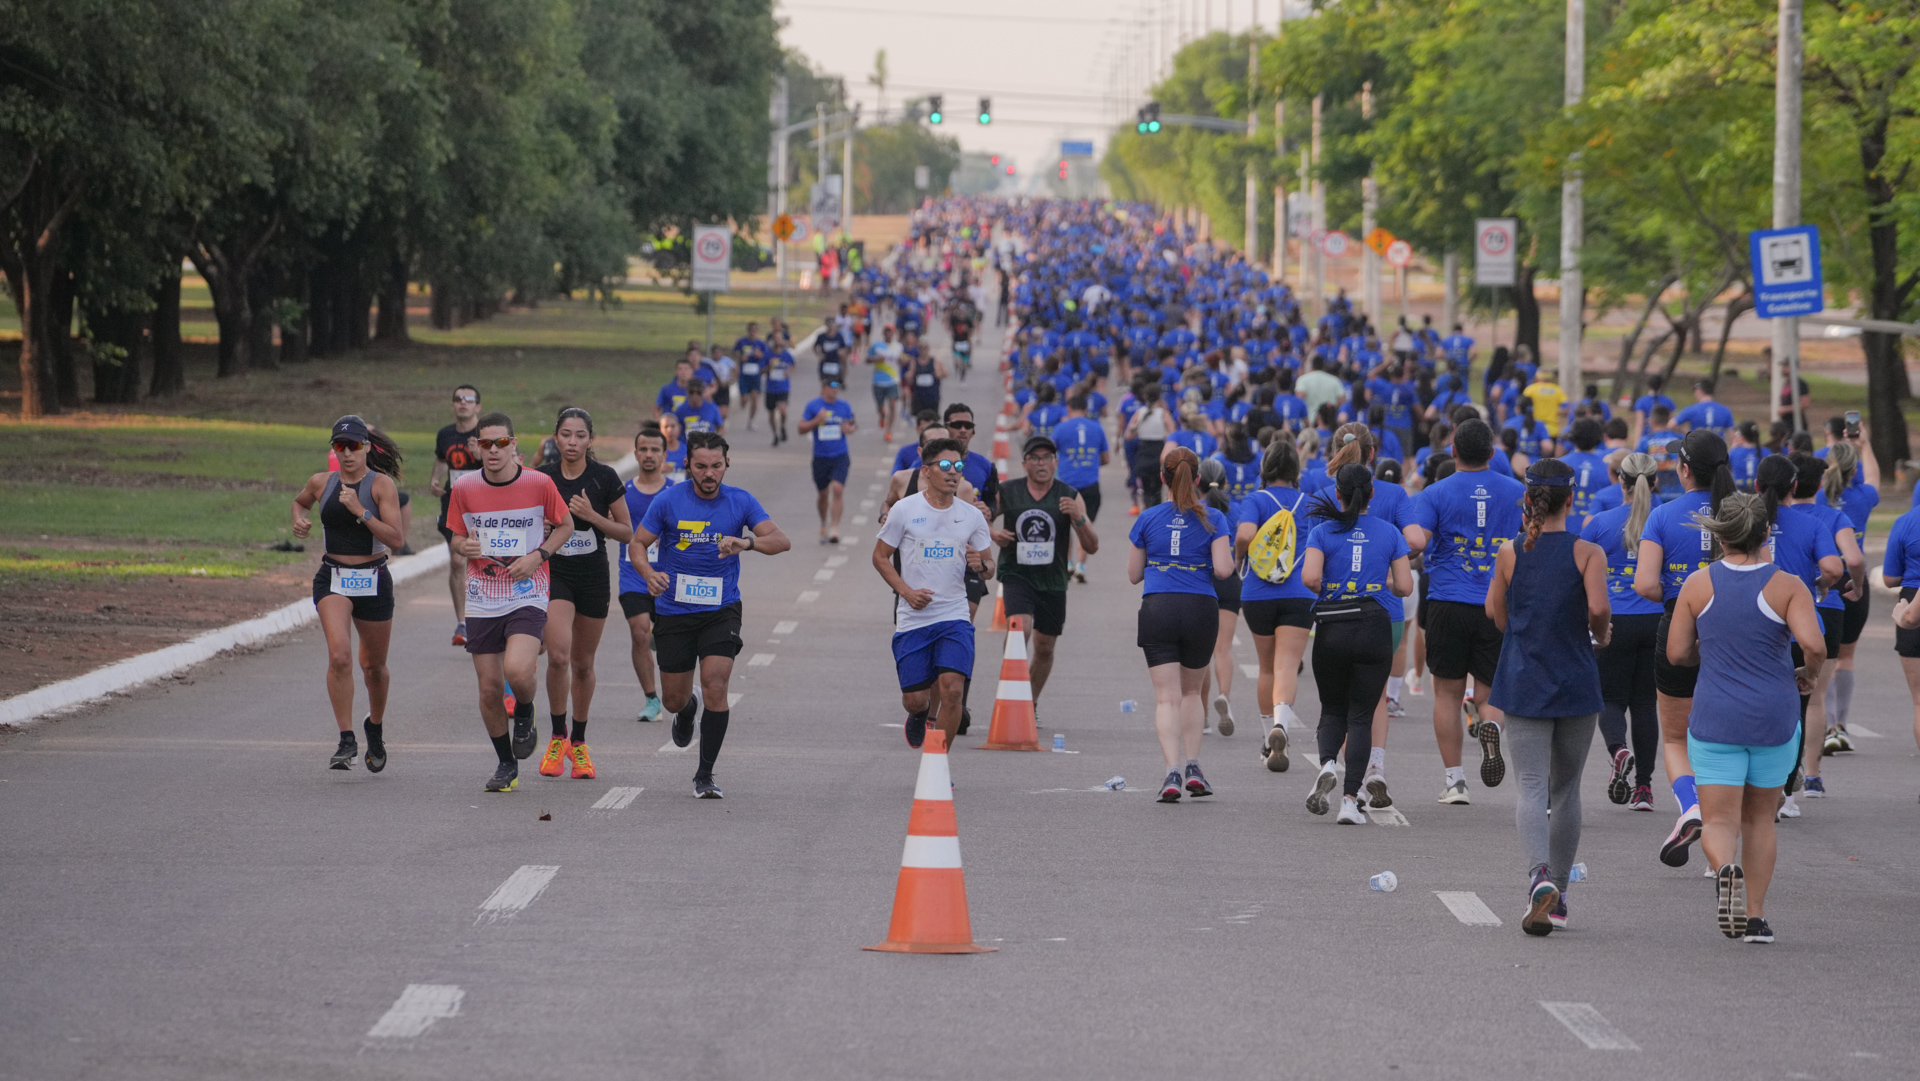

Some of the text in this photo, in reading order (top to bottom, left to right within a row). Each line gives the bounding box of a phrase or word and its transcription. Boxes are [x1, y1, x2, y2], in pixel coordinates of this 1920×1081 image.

[484, 517, 498, 528] de
[501, 517, 533, 528] Poeira
[490, 538, 518, 548] 5587
[564, 539, 591, 548] 5686
[926, 548, 952, 557] 1096
[1026, 550, 1049, 558] 5706
[343, 578, 369, 588] 1036
[689, 585, 714, 596] 1105
